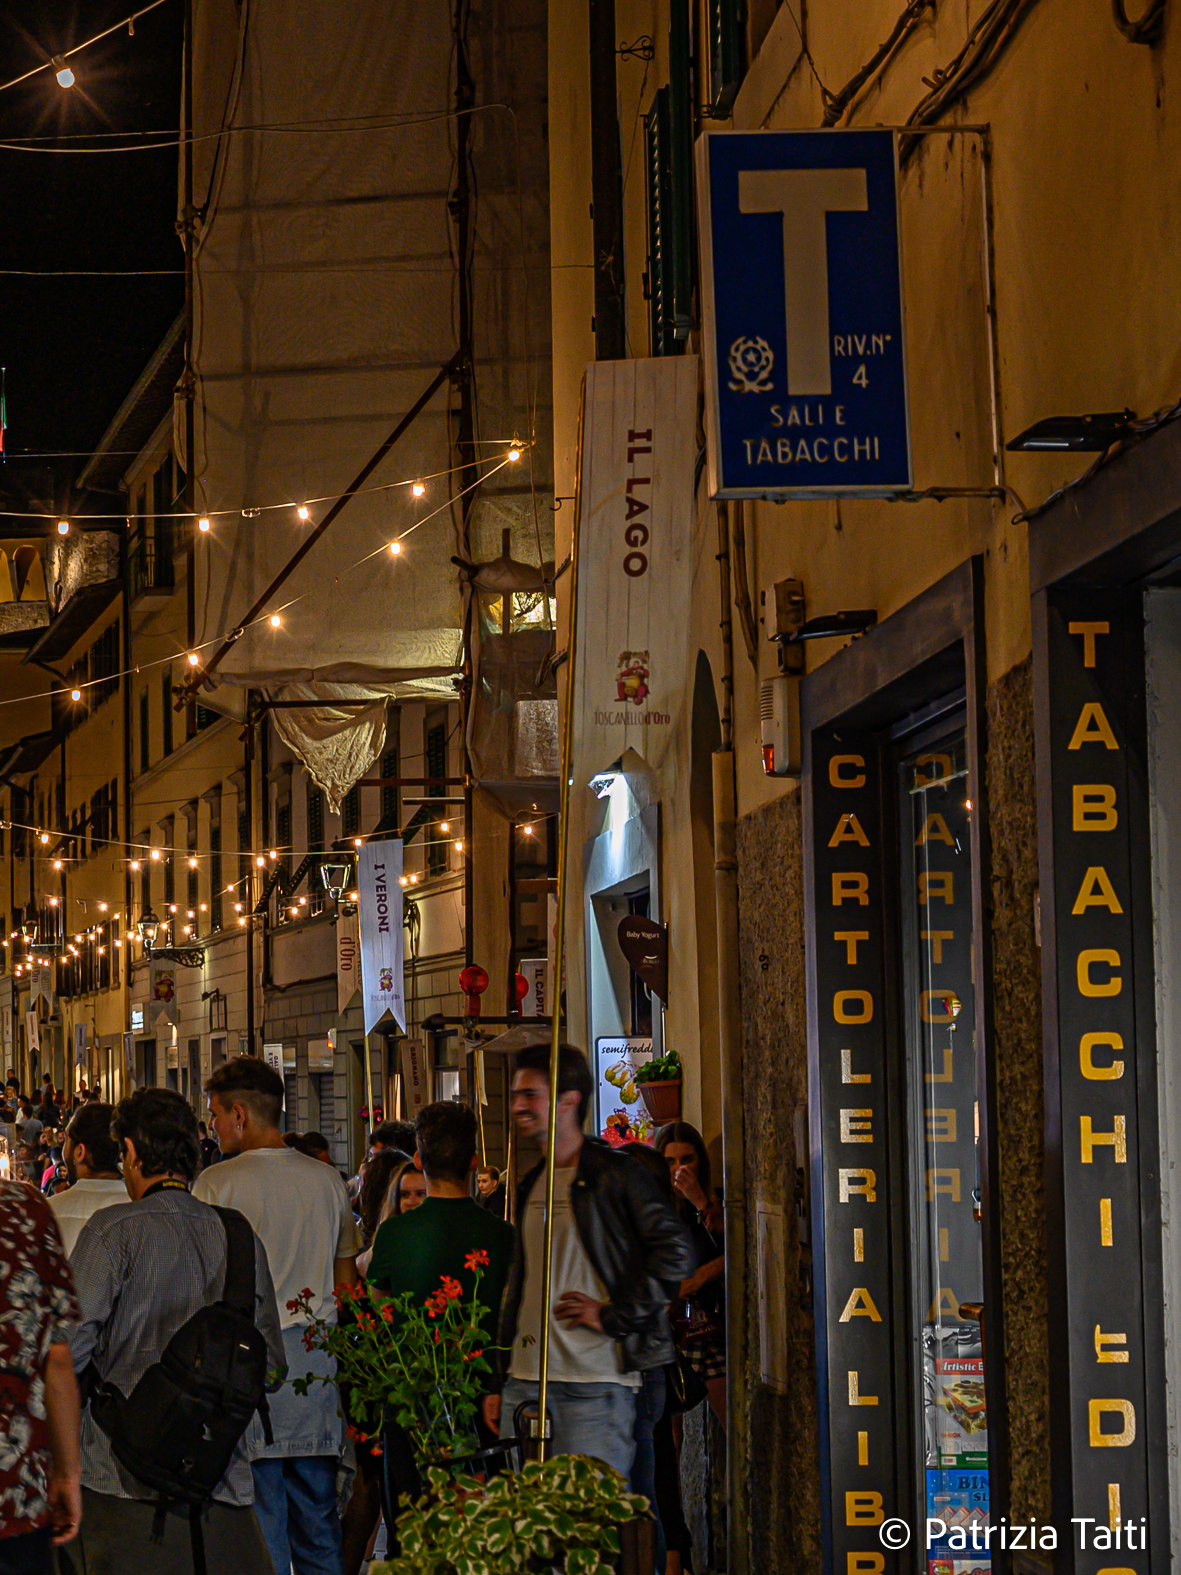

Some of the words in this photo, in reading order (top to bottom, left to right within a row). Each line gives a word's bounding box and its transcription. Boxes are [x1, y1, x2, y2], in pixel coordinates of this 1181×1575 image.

[738, 168, 868, 396] T
[852, 364, 869, 388] 4
[770, 405, 824, 427] SALI
[835, 405, 846, 425] E
[627, 428, 652, 463] IL
[743, 436, 880, 465] TABACCHI
[623, 477, 652, 577] LAGO
[375, 874, 390, 933] VERONI
[1068, 621, 1127, 1247] TABACCHI
[340, 936, 356, 971] d'Oro
[535, 968, 543, 979] IL
[535, 981, 545, 1017] CAPIT
[601, 1042, 653, 1059] semifredd
[827, 754, 883, 1322] CARTOLERIA
[941, 1361, 976, 1371] Artistic
[1088, 1323, 1137, 1575] EDI
